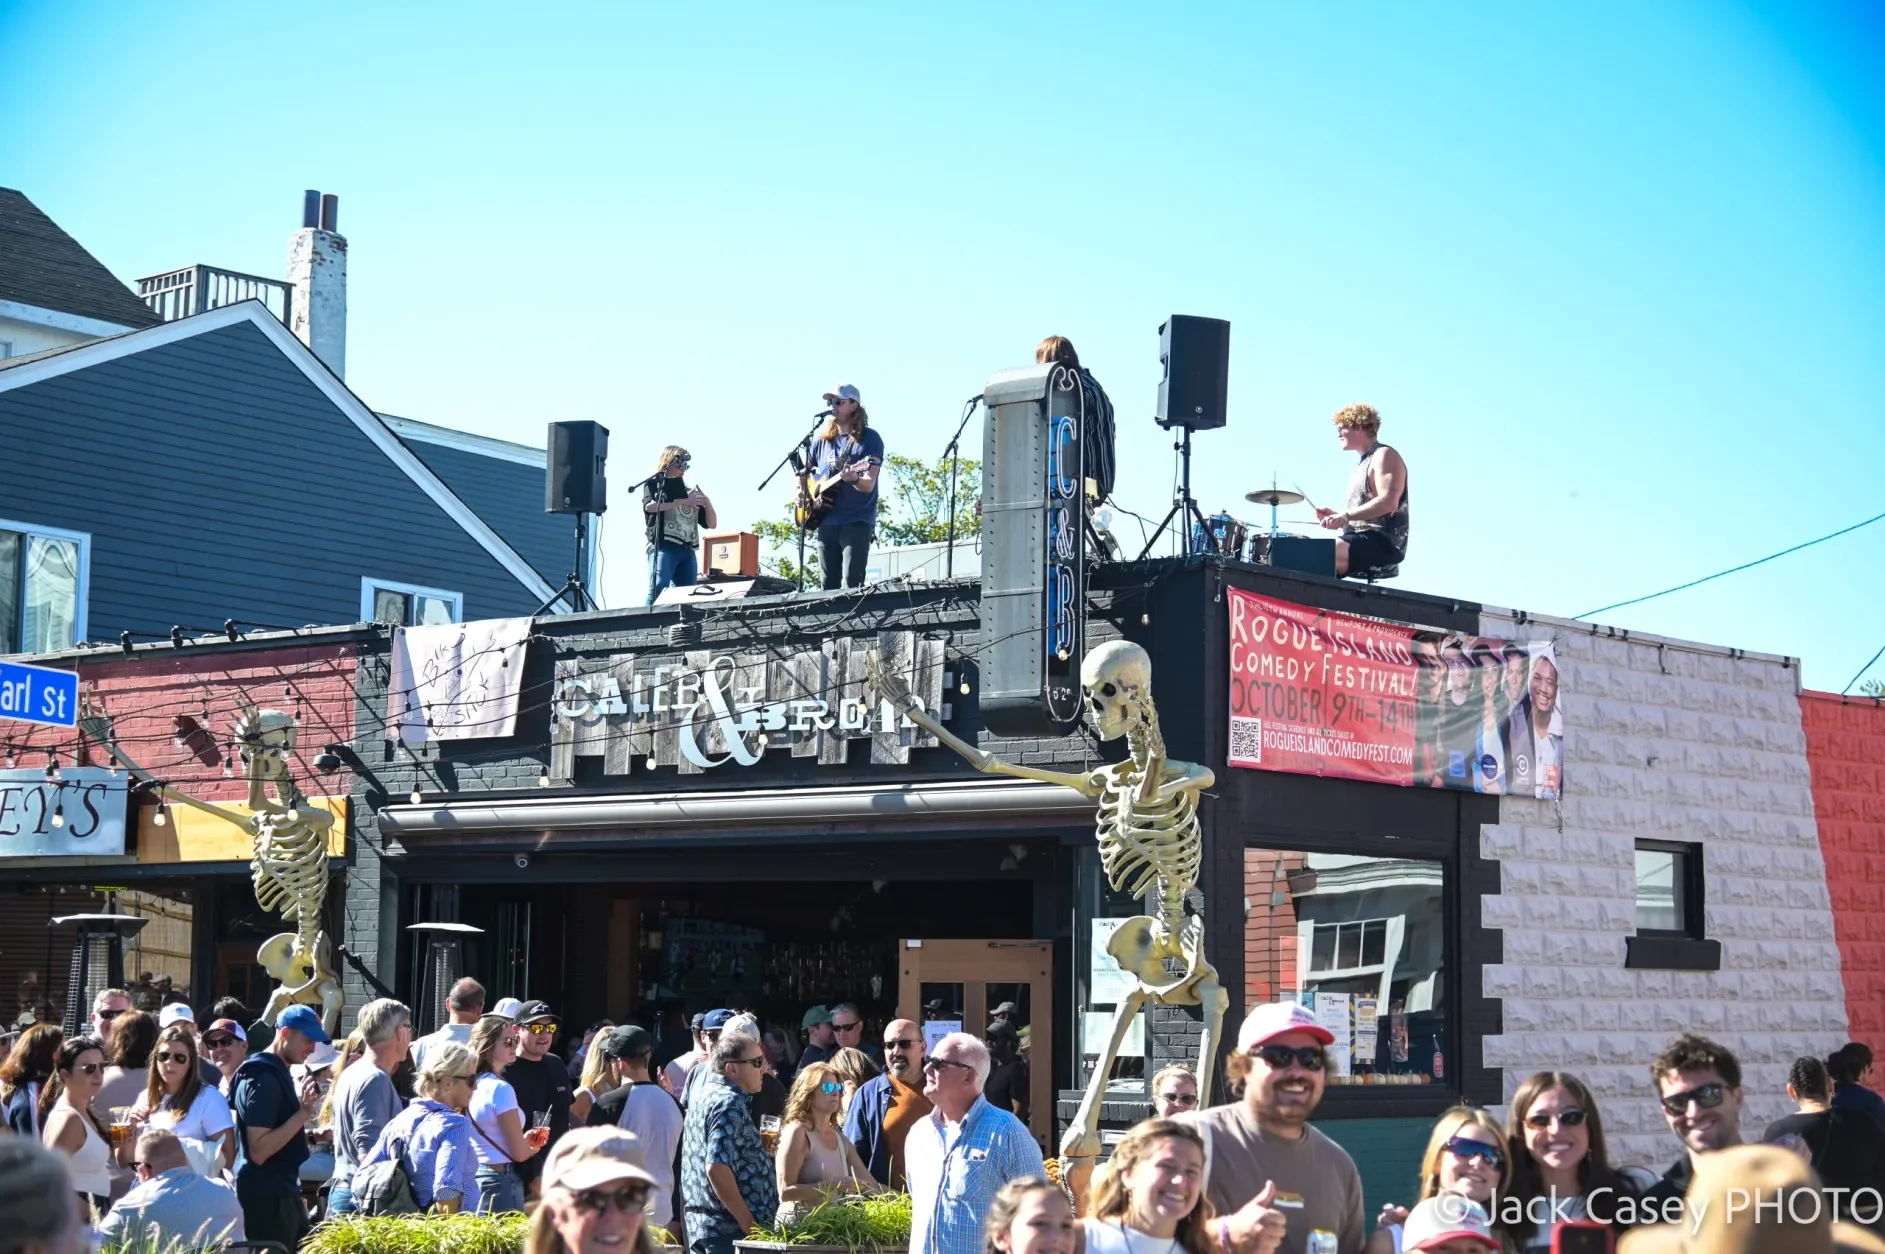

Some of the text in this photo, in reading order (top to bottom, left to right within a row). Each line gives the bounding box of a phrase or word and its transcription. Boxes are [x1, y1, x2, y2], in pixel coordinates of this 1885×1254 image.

[1231, 594, 1413, 667] ROGUE ISLAND
[1335, 618, 1366, 630] NEWPORT
[1373, 625, 1410, 638] PROVIDENCE
[0, 669, 67, 720] arl St
[1231, 641, 1418, 697] COMEDY FESTIVAL!
[557, 666, 708, 718] CALEB
[679, 655, 766, 769] &
[1231, 677, 1322, 725] OCTOBER
[1263, 730, 1413, 766] ROGUEISLANDCOMEDYFEST.COM
